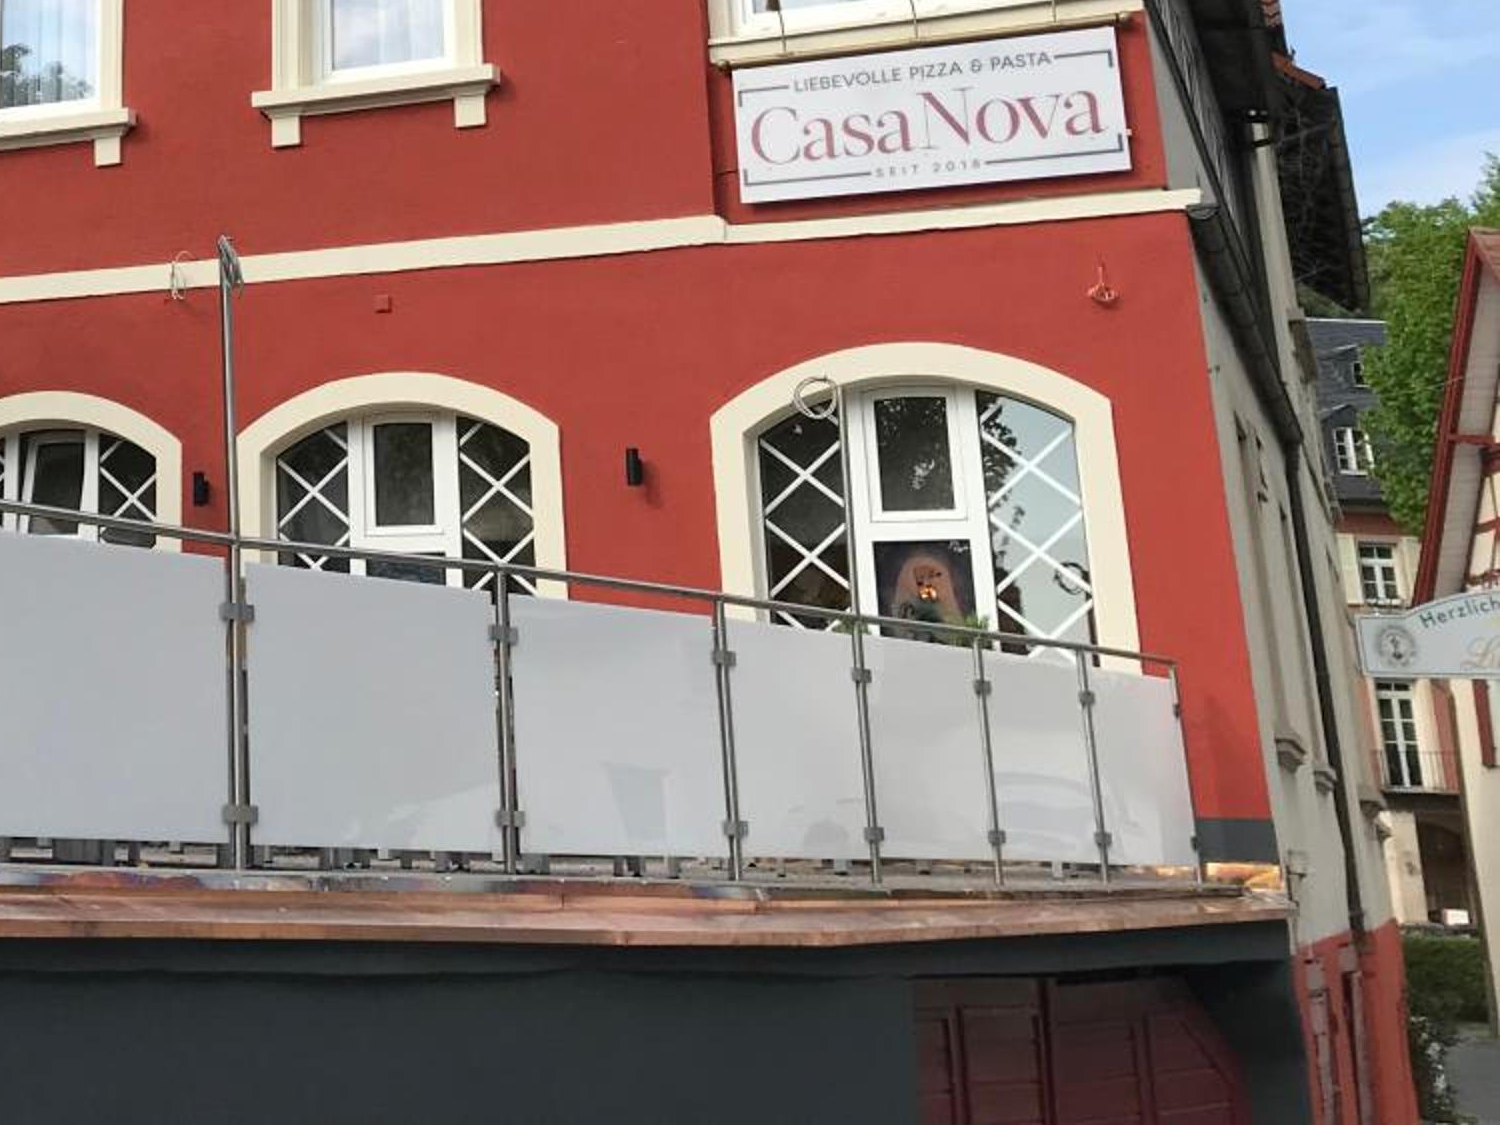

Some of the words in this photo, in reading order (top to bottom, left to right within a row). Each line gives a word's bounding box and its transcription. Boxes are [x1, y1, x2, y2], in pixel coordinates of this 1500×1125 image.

[794, 66, 902, 92] LIEBEVOLLE
[909, 61, 963, 81] PIZZA
[990, 51, 1052, 71] PASTA
[876, 163, 919, 178] SEIT
